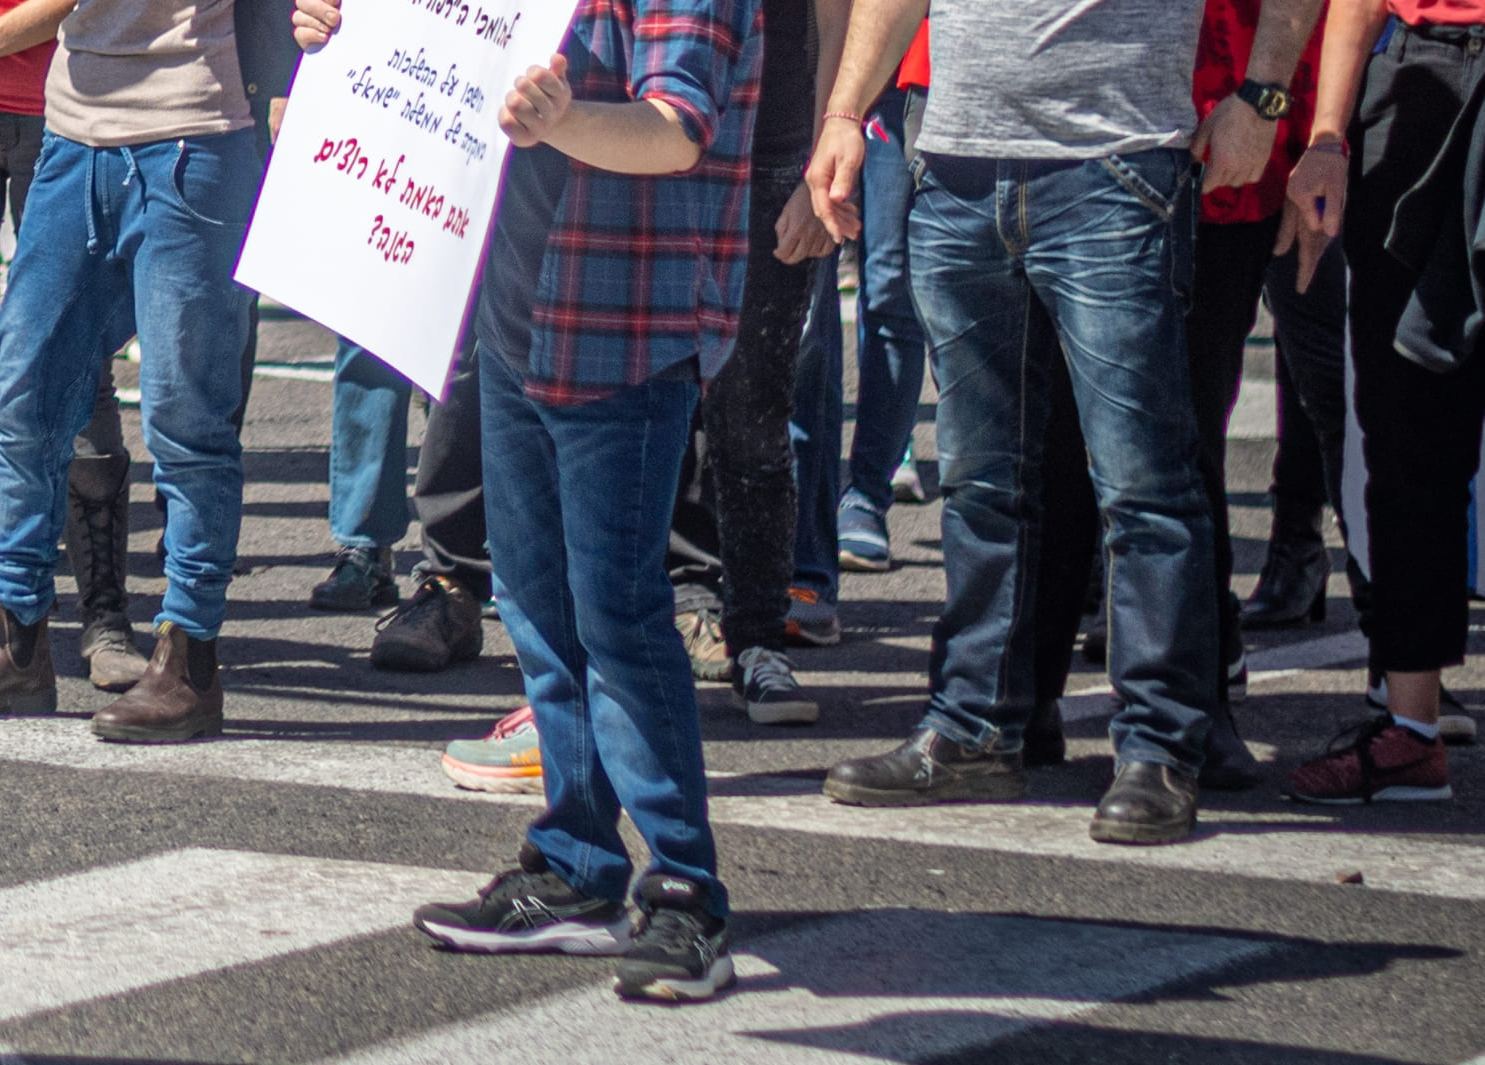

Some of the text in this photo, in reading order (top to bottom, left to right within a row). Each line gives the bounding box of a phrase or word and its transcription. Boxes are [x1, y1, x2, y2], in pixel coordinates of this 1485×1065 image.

[474, 7, 521, 50] לתומכי
[387, 47, 437, 87] ההשלכות
[440, 63, 460, 96] על
[400, 92, 443, 133] ממשלת
[444, 110, 462, 144] של
[313, 138, 469, 240] אתם באמת לא רוצים
[367, 214, 415, 265] הגנה?
